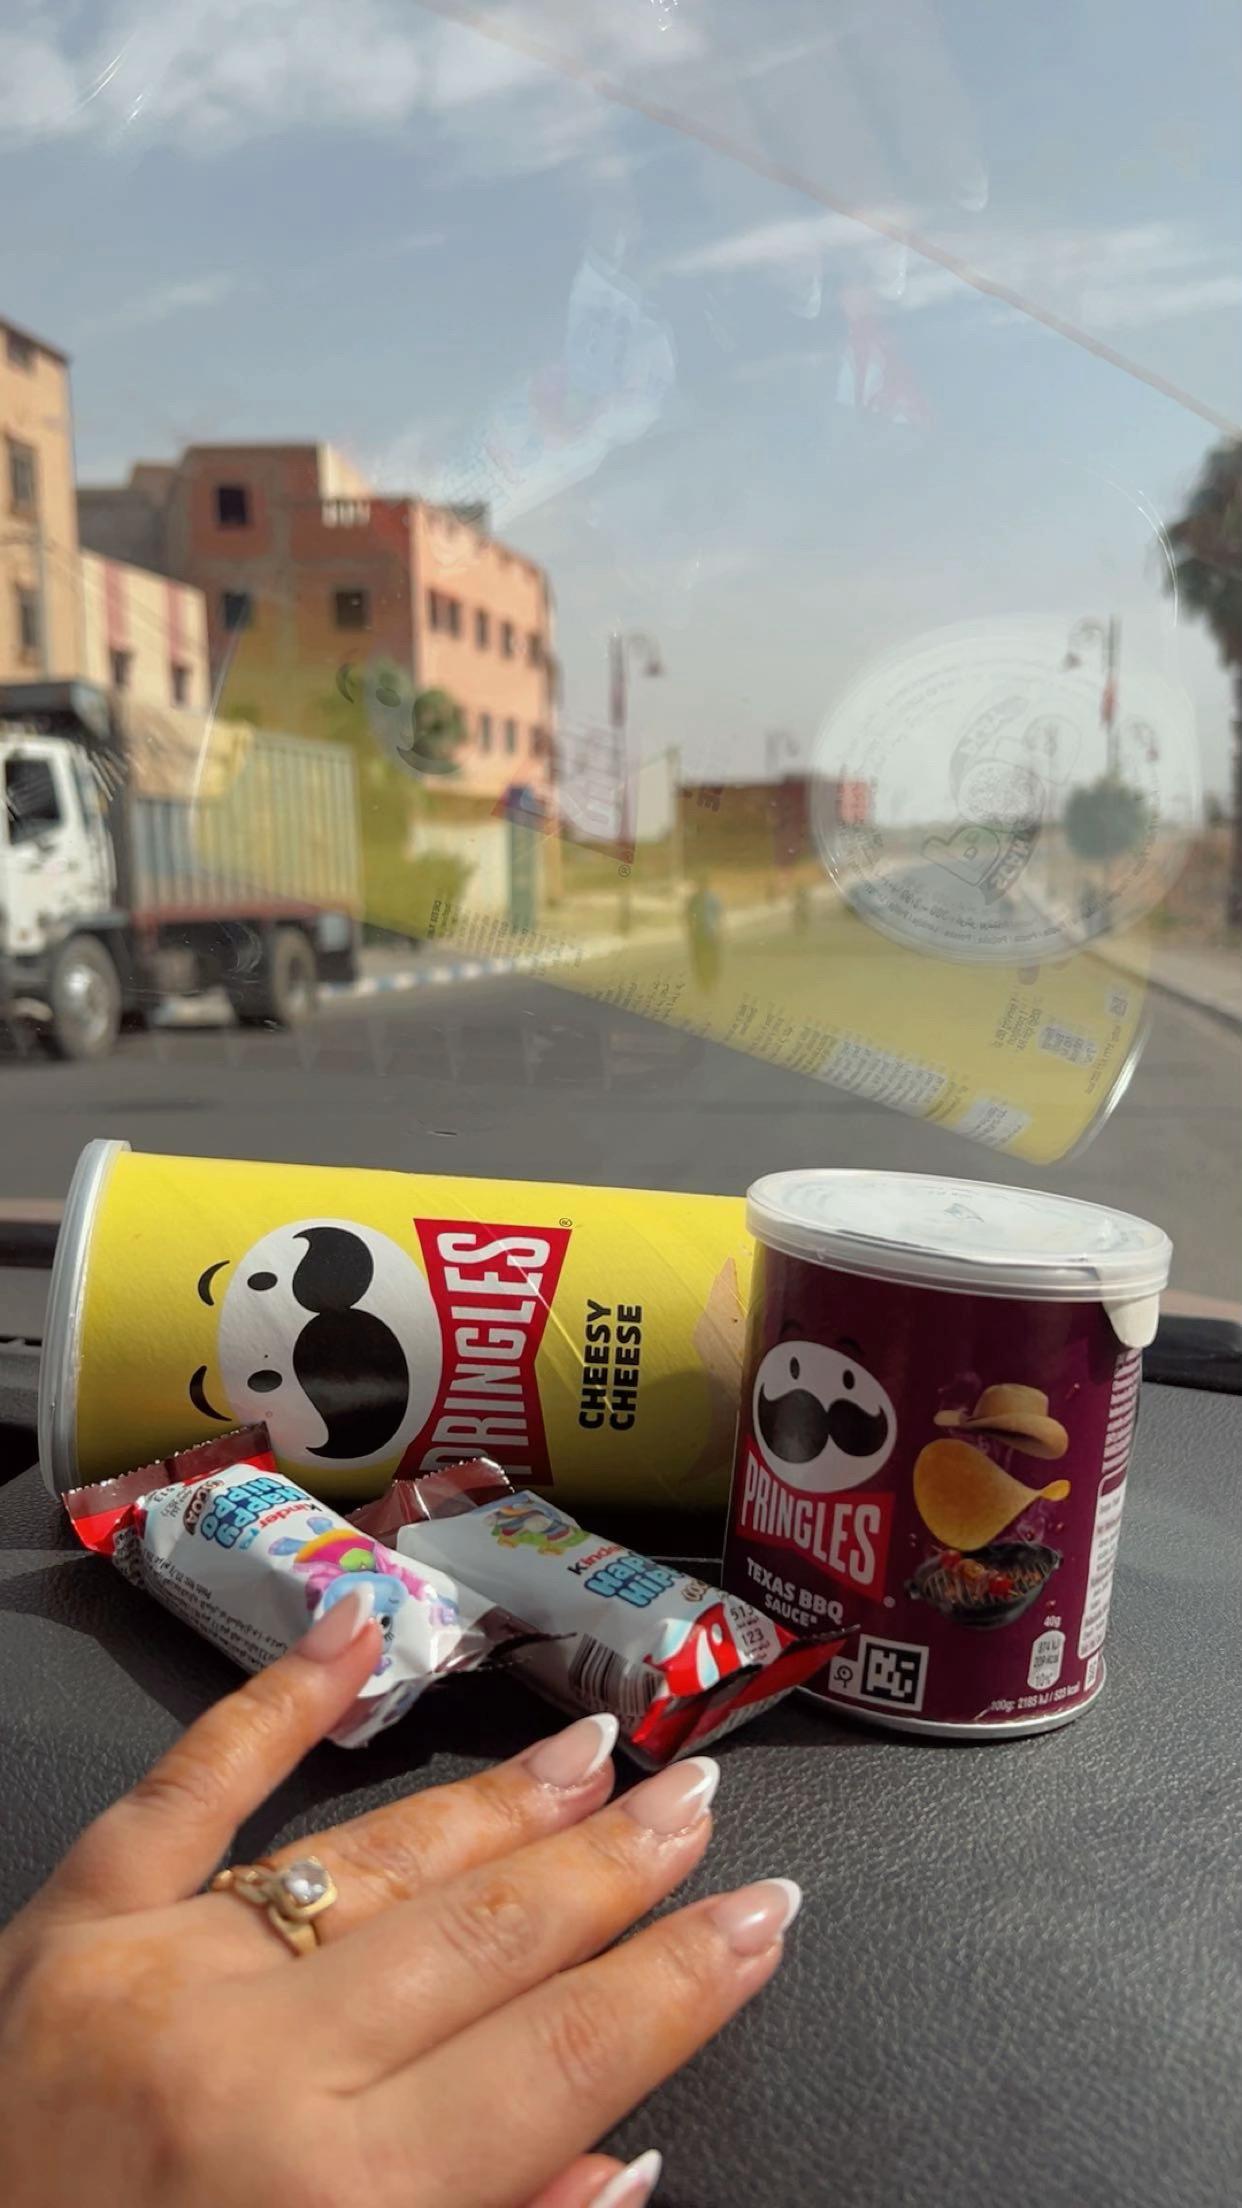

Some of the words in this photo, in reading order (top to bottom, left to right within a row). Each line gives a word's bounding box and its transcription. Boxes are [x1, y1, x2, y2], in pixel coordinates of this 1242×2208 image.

[579, 1299, 612, 1430] CHEESY
[609, 1304, 642, 1431] CHEESE
[741, 1449, 881, 1585] PRINGLES
[746, 1557, 796, 1601] TEXAS
[798, 1588, 844, 1625] BBQ
